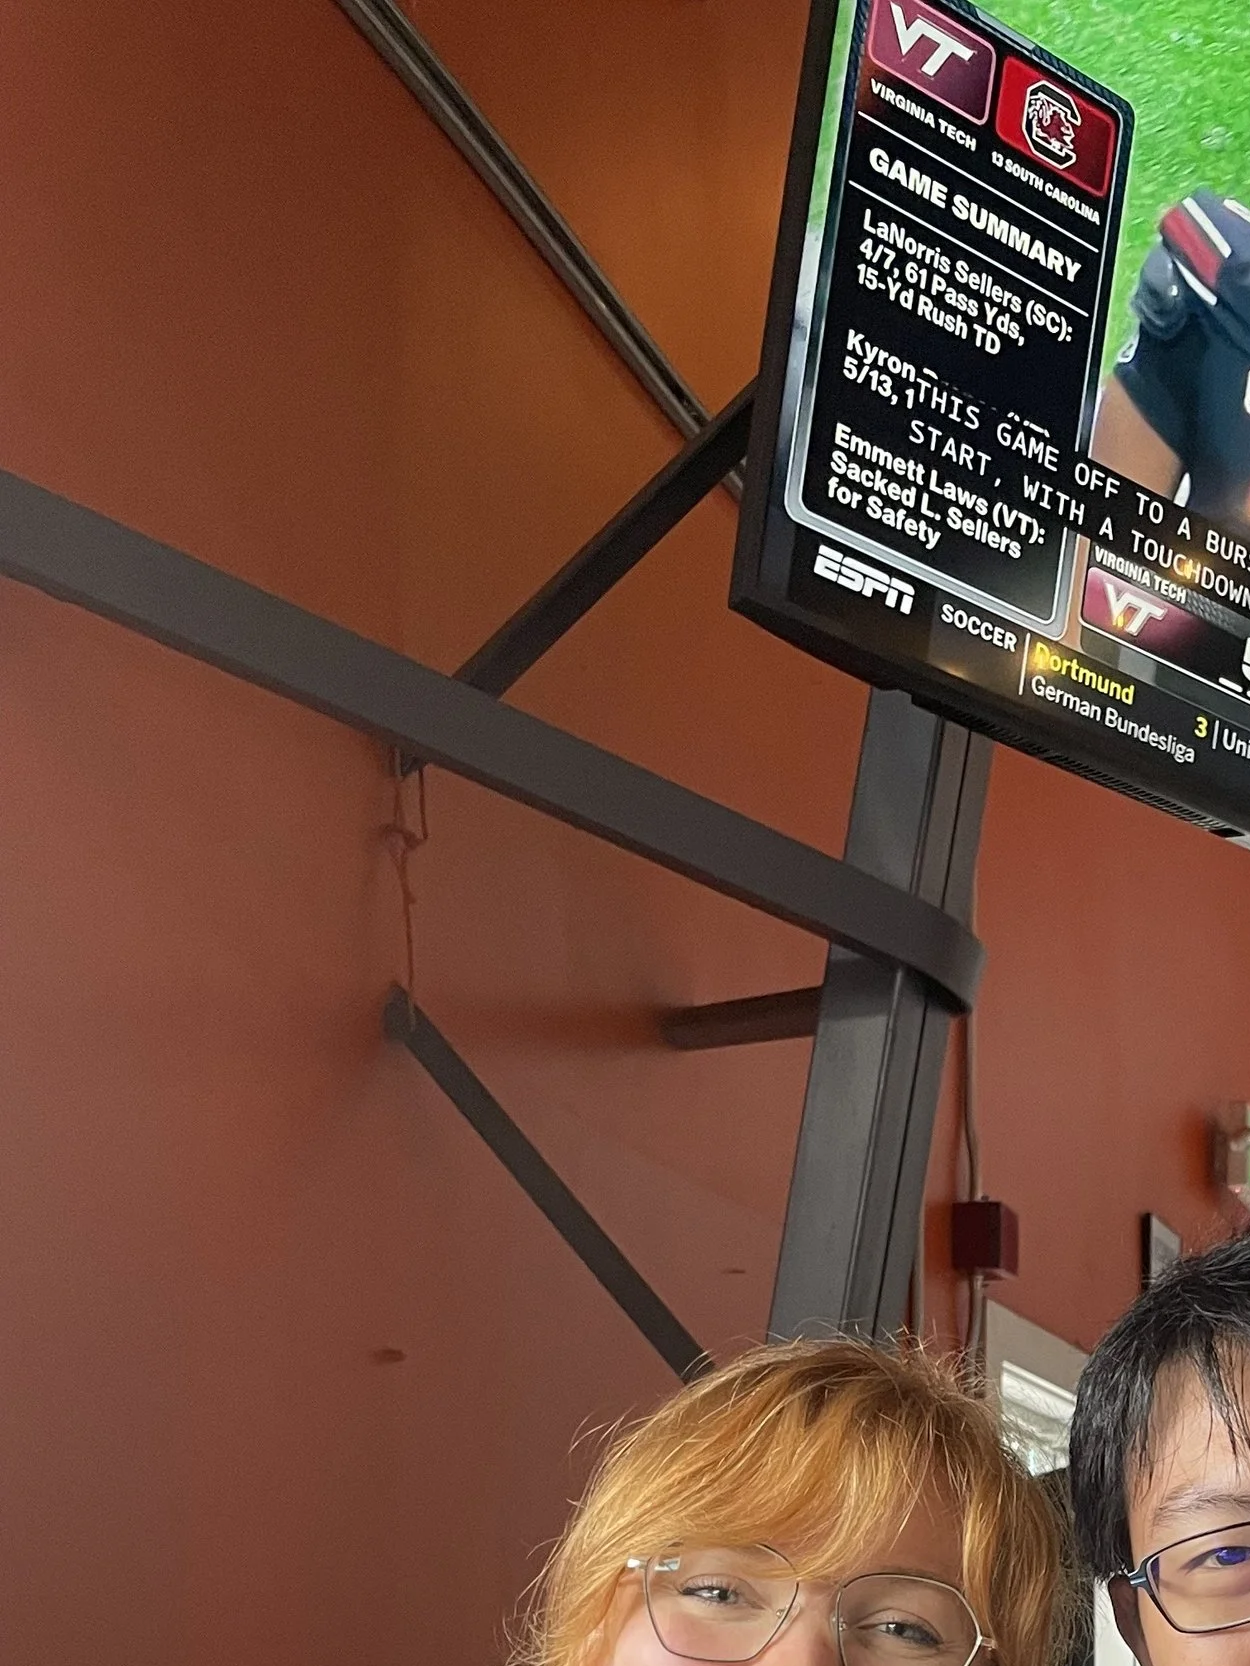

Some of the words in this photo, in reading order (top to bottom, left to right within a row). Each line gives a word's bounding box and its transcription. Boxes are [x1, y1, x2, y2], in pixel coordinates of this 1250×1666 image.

[889, 1, 978, 77] VT
[870, 78, 935, 129] VIRGINIA
[938, 118, 977, 151] TECH
[868, 147, 948, 209] GAME
[951, 193, 1083, 283] SUMMARY
[991, 151, 1003, 166] 13
[1004, 159, 1044, 193] SOUTH
[1044, 181, 1100, 225] CAROLINA
[856, 263, 914, 310] 15-Yd
[916, 295, 968, 340] Rush
[972, 325, 1001, 356] TD
[859, 239, 900, 279] 4/7,
[904, 259, 928, 289] 61
[931, 275, 979, 316] Pass
[984, 306, 1025, 347] Yds,
[863, 208, 951, 275] LaNorris
[954, 260, 1022, 314] Sellers
[1025, 299, 1073, 342] (SC):
[842, 357, 898, 407] 5/13,
[846, 329, 917, 382] Kyron
[834, 422, 925, 487] Emmett
[929, 469, 988, 516] Laws
[992, 502, 1046, 544] (VT):
[916, 377, 980, 430] THIS
[996, 422, 1060, 472] GAME
[1074, 462, 1121, 499] OFF
[1136, 491, 1164, 524] TO
[1177, 517, 1191, 540] A
[828, 477, 862, 509] for
[865, 496, 941, 550] Safety
[829, 451, 917, 509] Sacked
[921, 492, 942, 521] L.
[947, 507, 1022, 559] Sellers
[1023, 474, 1085, 526] WITH
[1099, 517, 1114, 541] A
[813, 544, 916, 615] ESPN
[1094, 545, 1151, 586] VIRGINIA
[1153, 575, 1187, 604] TECH
[1104, 580, 1168, 637] VT
[941, 603, 1018, 652] SOCCER
[1031, 675, 1101, 722] German
[1104, 707, 1196, 764] Bundesliga
[1034, 641, 1135, 706] Dortmund
[1194, 717, 1208, 738] 3
